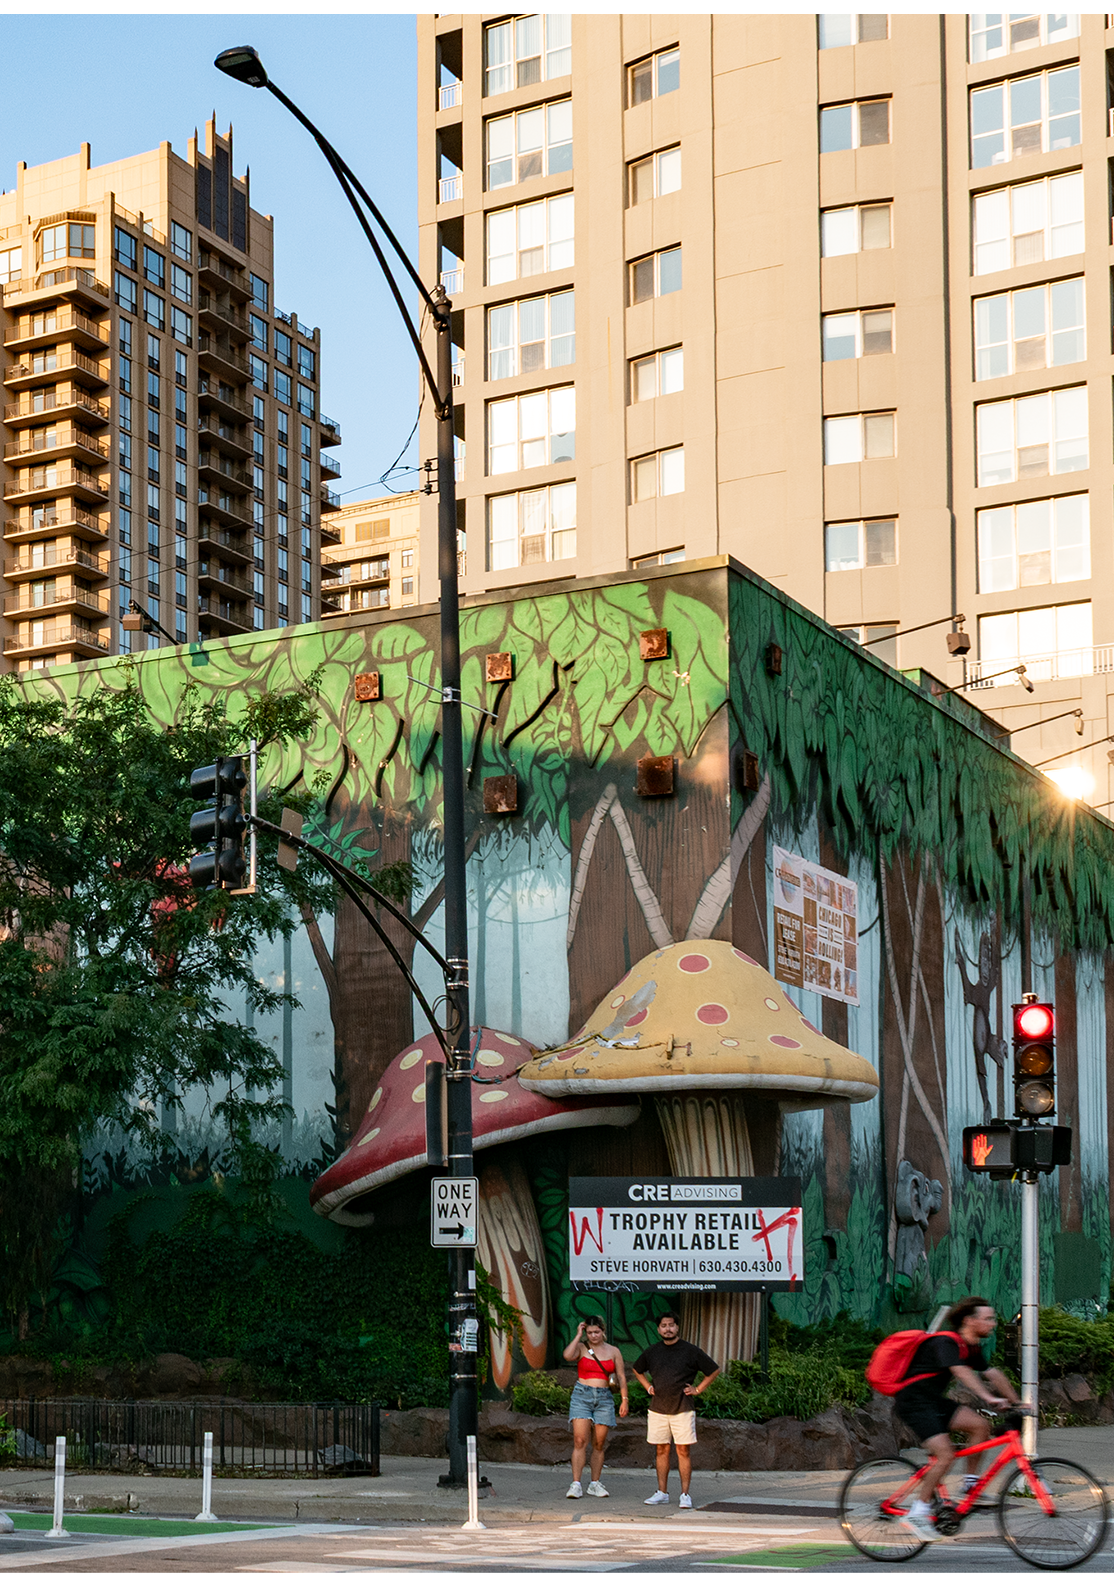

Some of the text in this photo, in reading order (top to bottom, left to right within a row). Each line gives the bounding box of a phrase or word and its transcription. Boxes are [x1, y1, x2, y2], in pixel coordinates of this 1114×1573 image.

[438, 1184, 472, 1200] ONE
[628, 1184, 738, 1201] CRE ADVISING
[437, 1203, 473, 1218] WAY
[609, 1213, 760, 1230] TROPHY RETAIL
[632, 1233, 739, 1250] AVAILABLE
[590, 1260, 782, 1273] STEVE HORVATH 630.430.4300
[657, 1282, 717, 1291] www.creadvising.com
